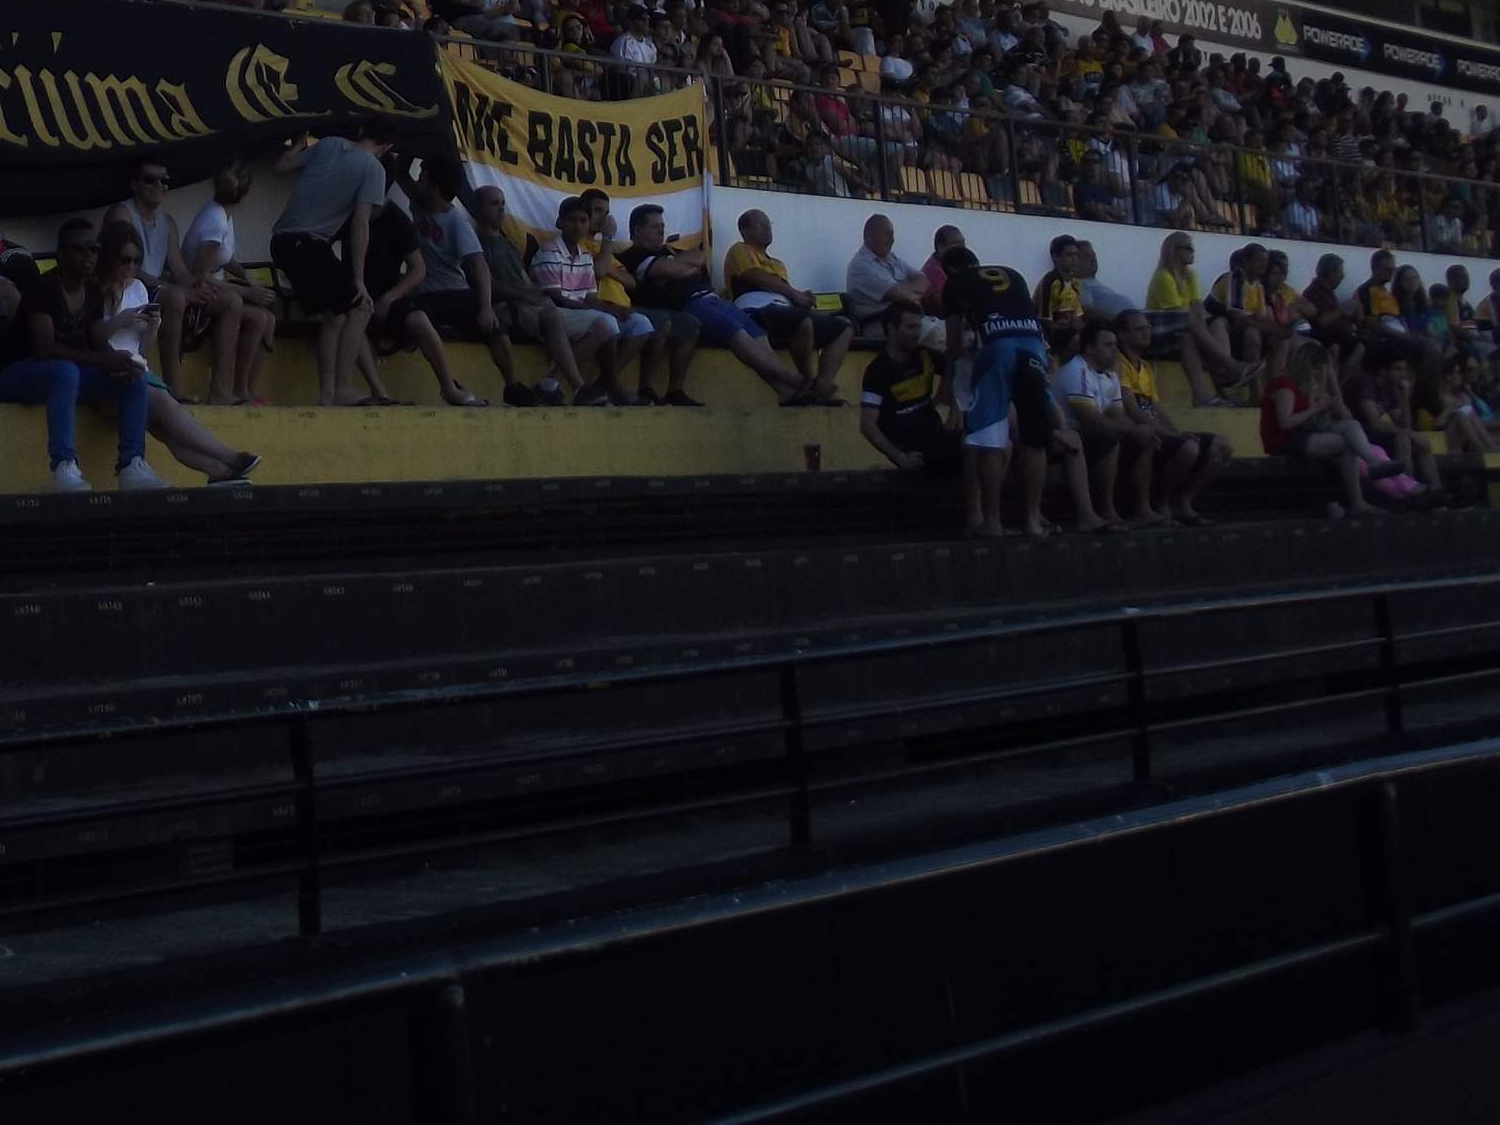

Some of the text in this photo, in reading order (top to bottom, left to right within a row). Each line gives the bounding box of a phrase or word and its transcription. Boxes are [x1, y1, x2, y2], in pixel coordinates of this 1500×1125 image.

[1216, 9, 1228, 33] E
[1227, 10, 1262, 40] 2006
[1302, 24, 1366, 54] POWERADE
[1383, 43, 1442, 70] POWERADE
[527, 110, 636, 187] BASTA
[646, 115, 704, 184] SER
